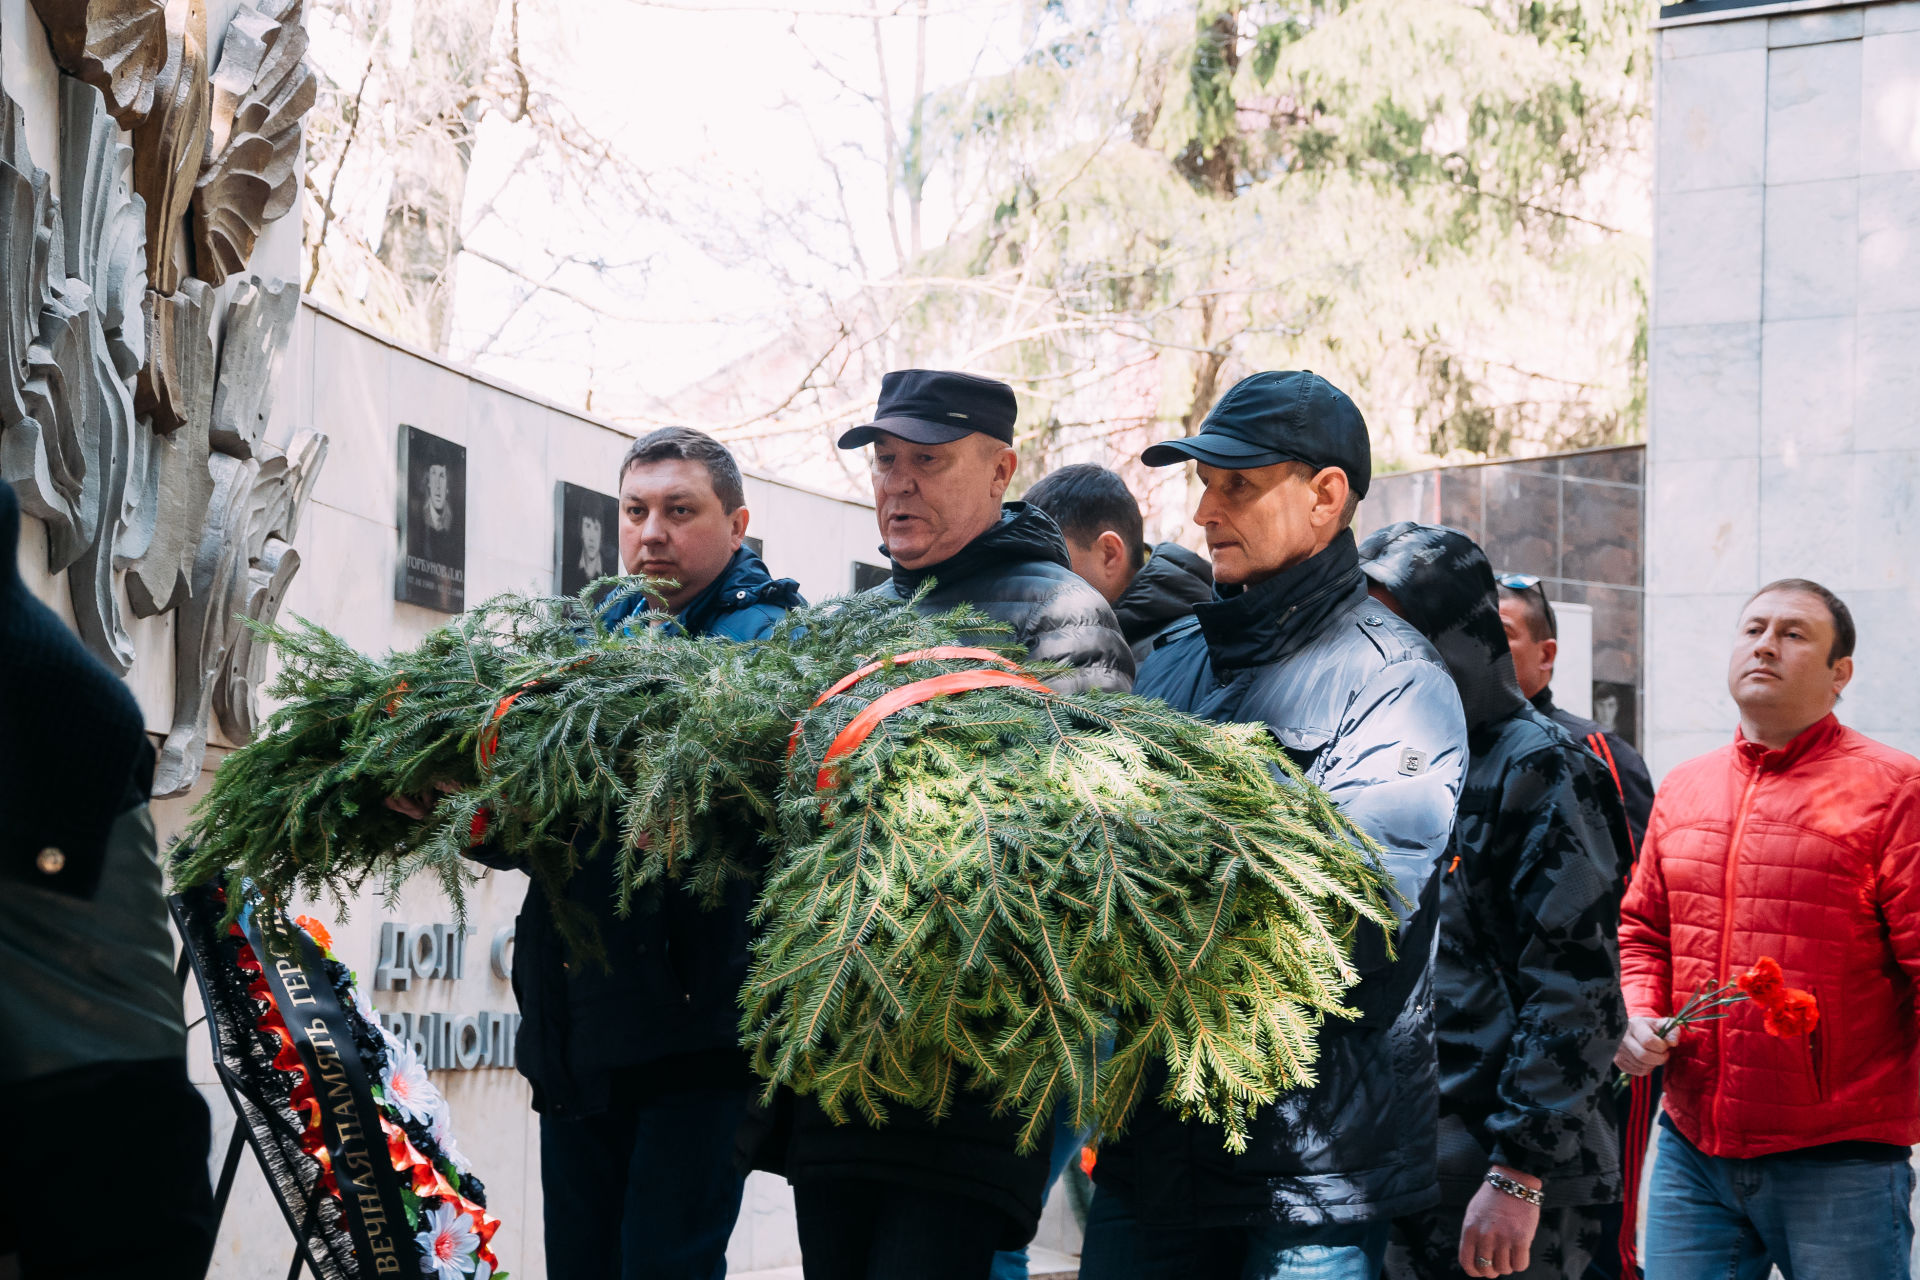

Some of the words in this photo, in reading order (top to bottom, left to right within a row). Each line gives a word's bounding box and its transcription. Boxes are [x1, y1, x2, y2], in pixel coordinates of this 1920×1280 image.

[375, 922, 478, 991] ДОЛГ
[304, 1018, 364, 1145] ПАМЯТЬ
[345, 1148, 400, 1276] ВЕЧНАЯ
